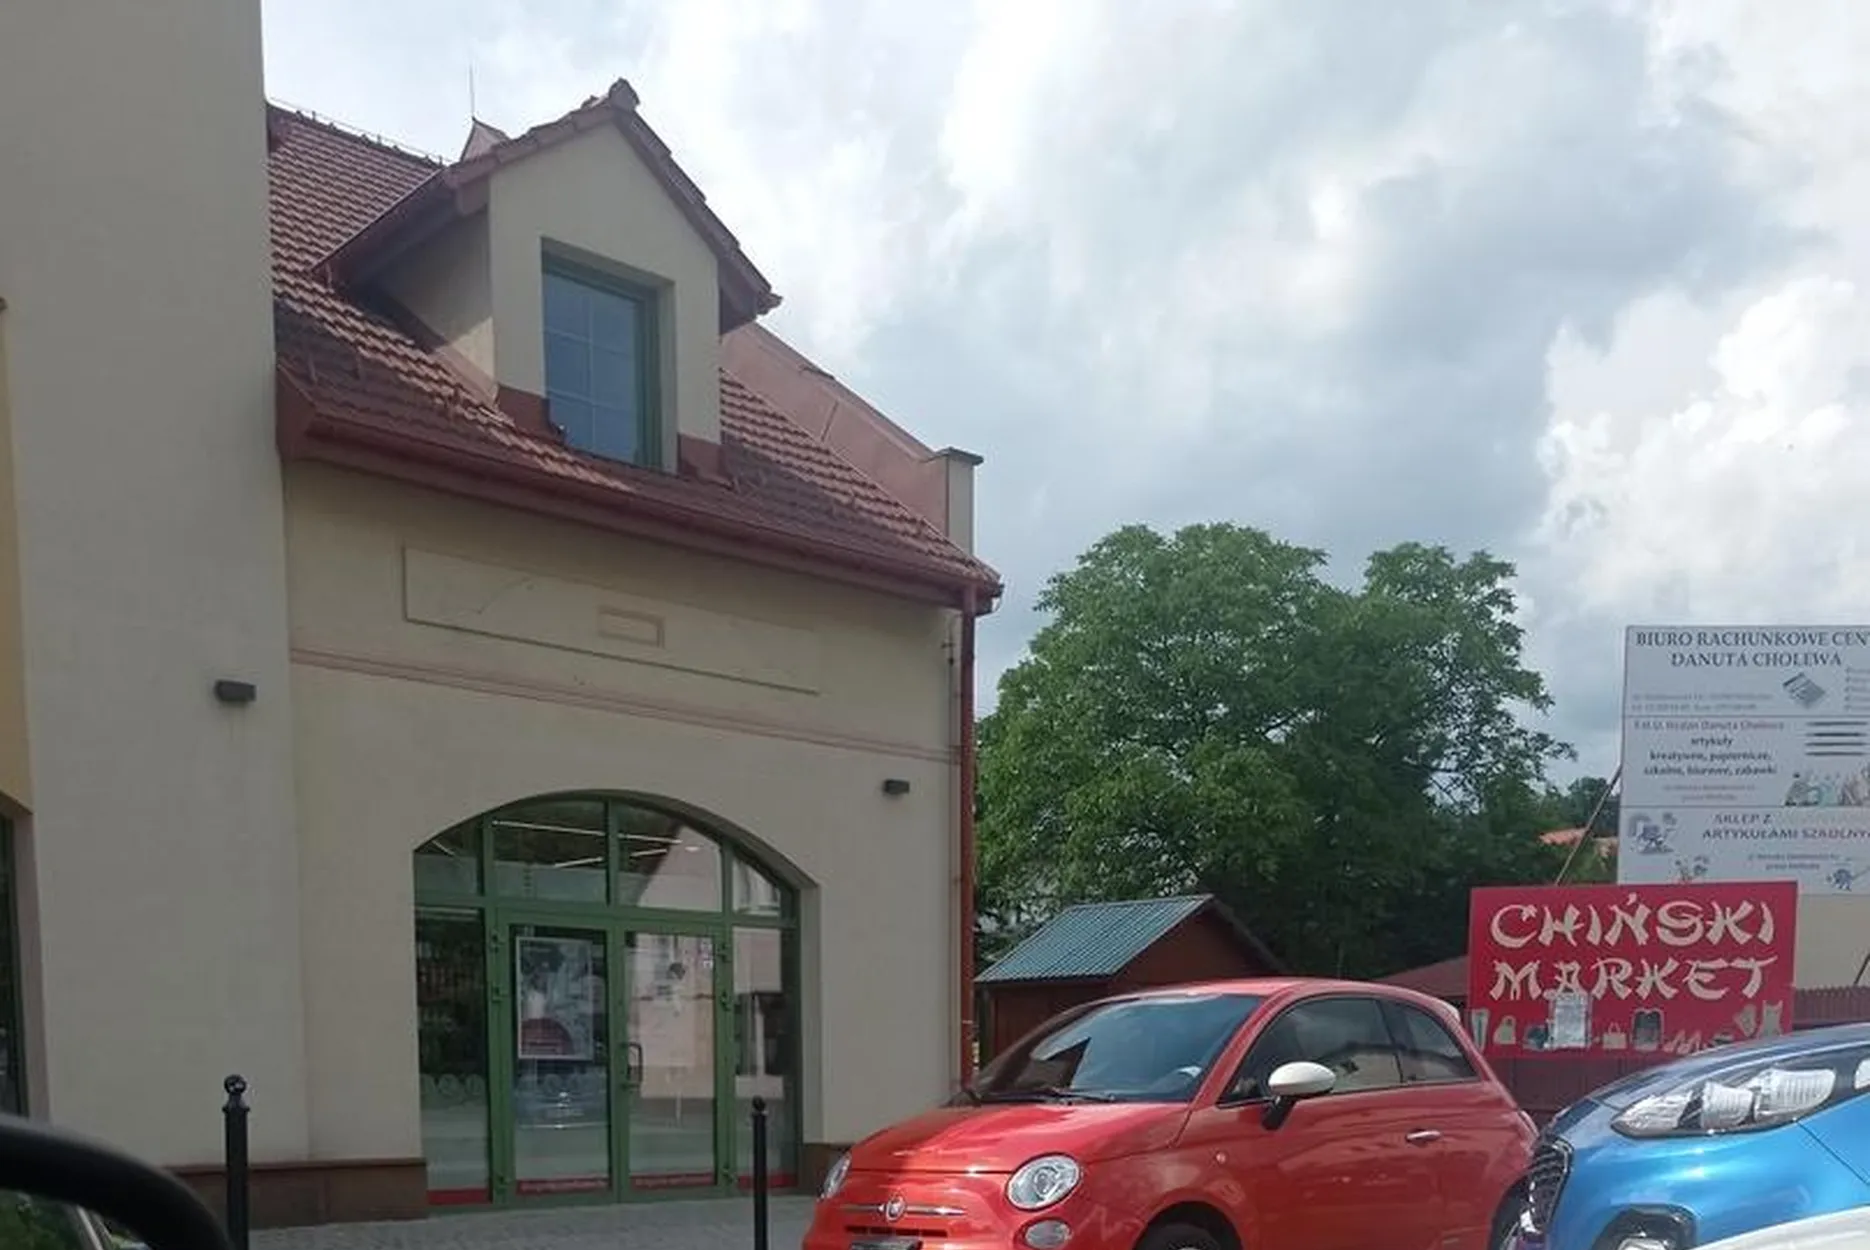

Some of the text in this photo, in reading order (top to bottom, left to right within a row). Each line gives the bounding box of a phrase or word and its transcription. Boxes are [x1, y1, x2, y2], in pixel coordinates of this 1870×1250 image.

[1636, 631, 1693, 646] BIURO
[1698, 632, 1829, 646] RACHUNKOWE
[1671, 653, 1842, 667] DANUTA CHOLEWA
[1714, 814, 1760, 825] SKLEP
[1489, 893, 1774, 948] CHIŃSKI
[1489, 955, 1777, 1000] MARKET
